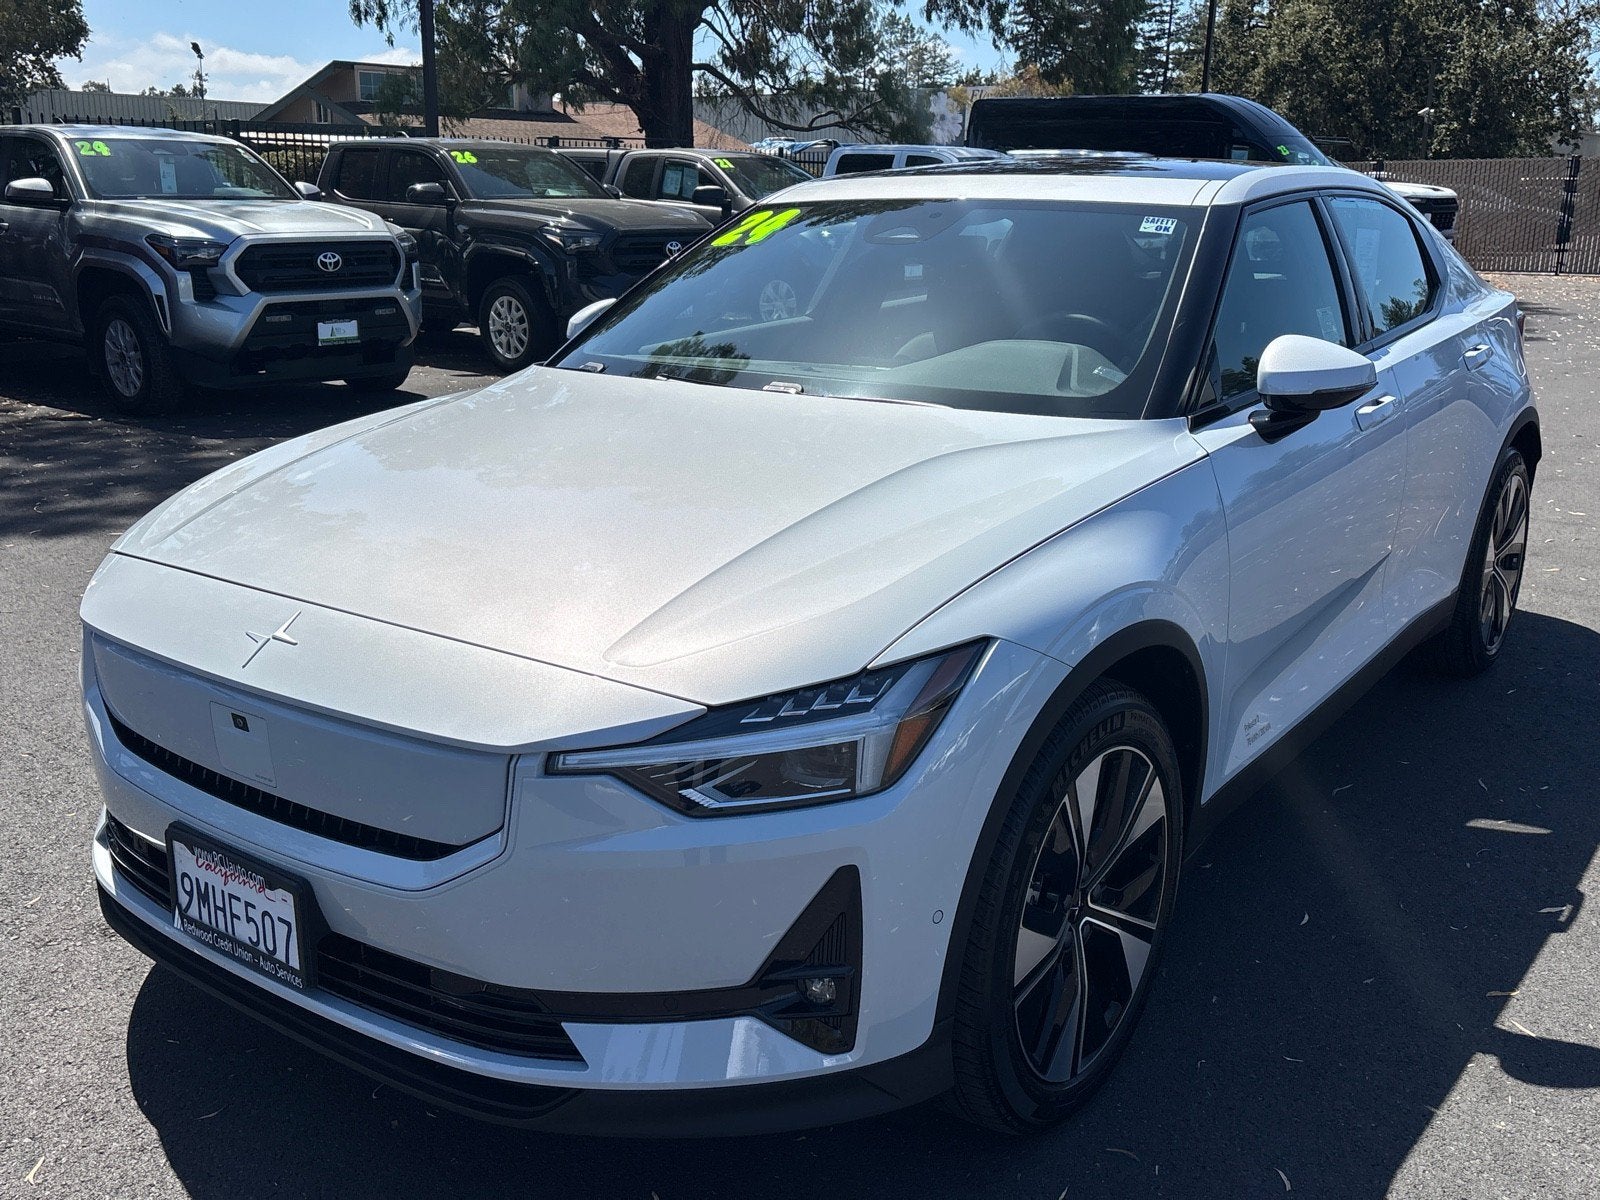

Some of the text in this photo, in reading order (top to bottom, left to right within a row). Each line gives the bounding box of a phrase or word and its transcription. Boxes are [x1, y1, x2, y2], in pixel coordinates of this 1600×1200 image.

[450, 151, 478, 164] 26
[714, 158, 736, 169] 21
[711, 208, 801, 247] 24
[1144, 217, 1176, 226] SAFETY
[1154, 225, 1171, 233] OK
[1050, 711, 1126, 797] MICHELIN
[180, 871, 292, 965] 9MHF507
[184, 918, 213, 944] Redwood
[213, 933, 233, 954] Credit
[233, 942, 254, 964] Union
[259, 955, 276, 974] Auto
[276, 963, 303, 989] Services
